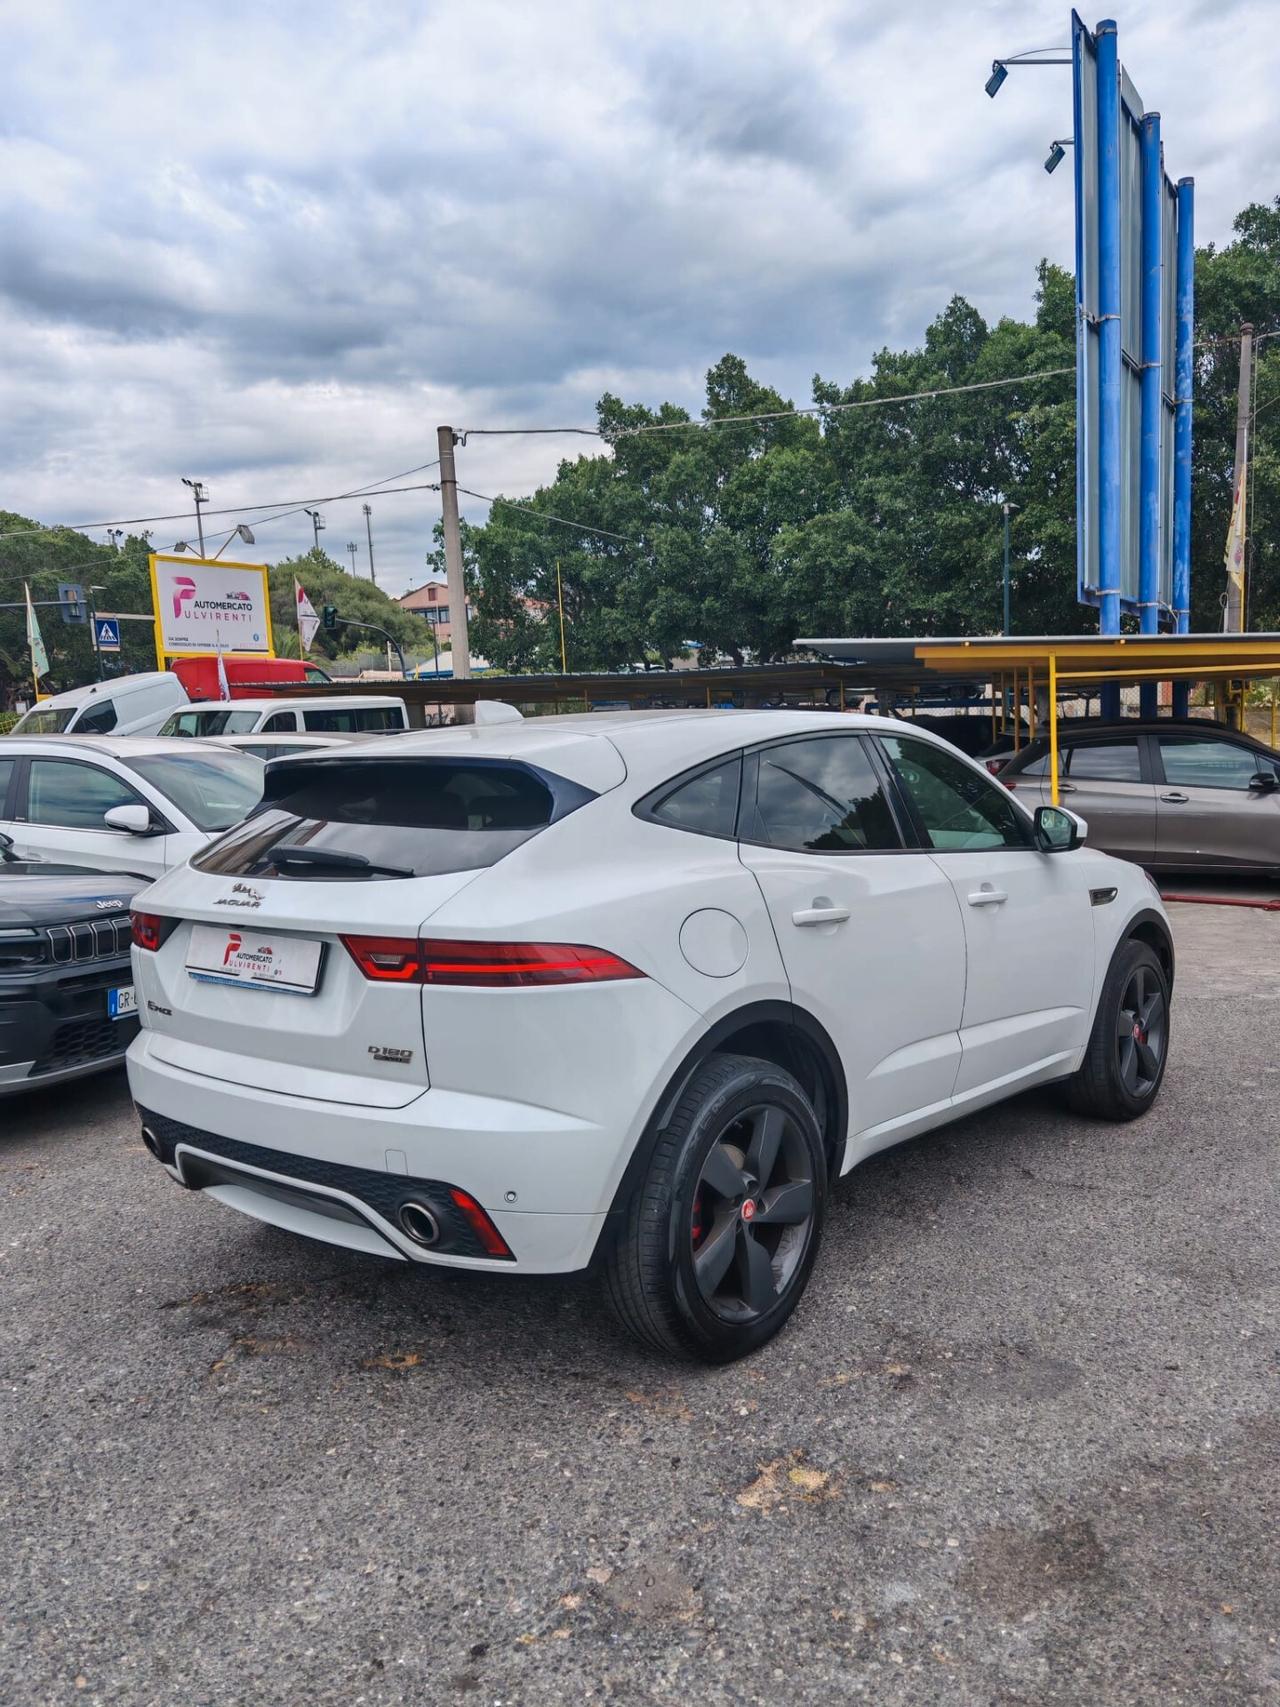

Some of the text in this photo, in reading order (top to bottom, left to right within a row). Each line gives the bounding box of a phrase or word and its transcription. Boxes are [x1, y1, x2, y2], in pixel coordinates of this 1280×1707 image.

[194, 600, 253, 611] AUTOMERCATO
[96, 899, 123, 909] Jeep
[213, 899, 262, 908] JAGUAR
[236, 952, 273, 964] AUTOMERCATO
[368, 1046, 413, 1058] D180
